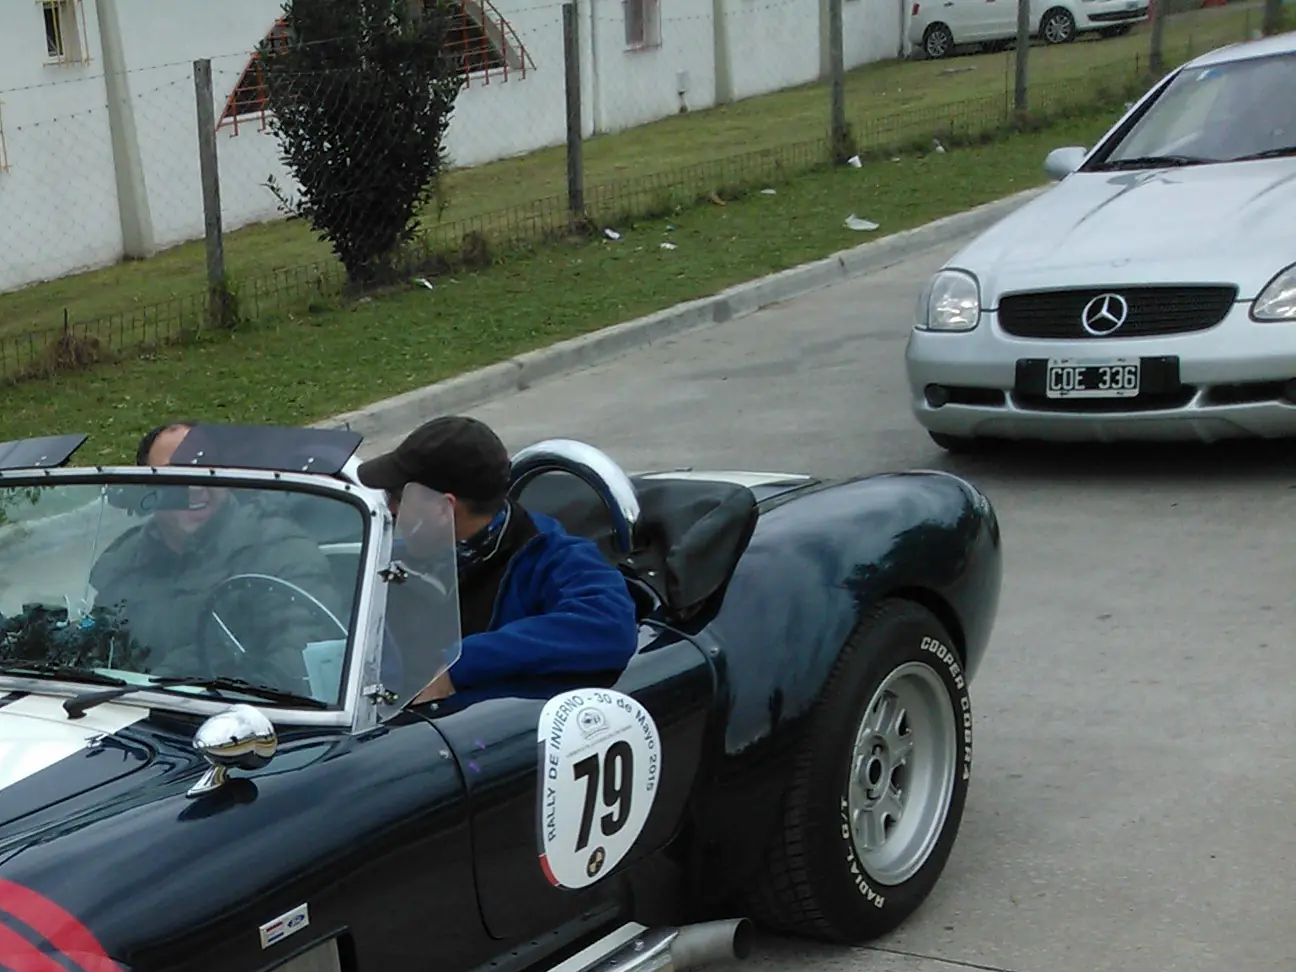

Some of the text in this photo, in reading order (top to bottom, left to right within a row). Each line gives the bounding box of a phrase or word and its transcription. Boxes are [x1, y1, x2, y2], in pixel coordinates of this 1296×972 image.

[1098, 366, 1136, 389] 336
[550, 695, 584, 750] INVIERNO
[616, 698, 632, 713] de
[634, 709, 655, 750] Mayo
[920, 636, 973, 782] COOPER COBRA
[551, 755, 559, 780] DE
[546, 787, 557, 842] RALLY
[572, 740, 634, 853] 79
[846, 847, 886, 909] RADIAL
